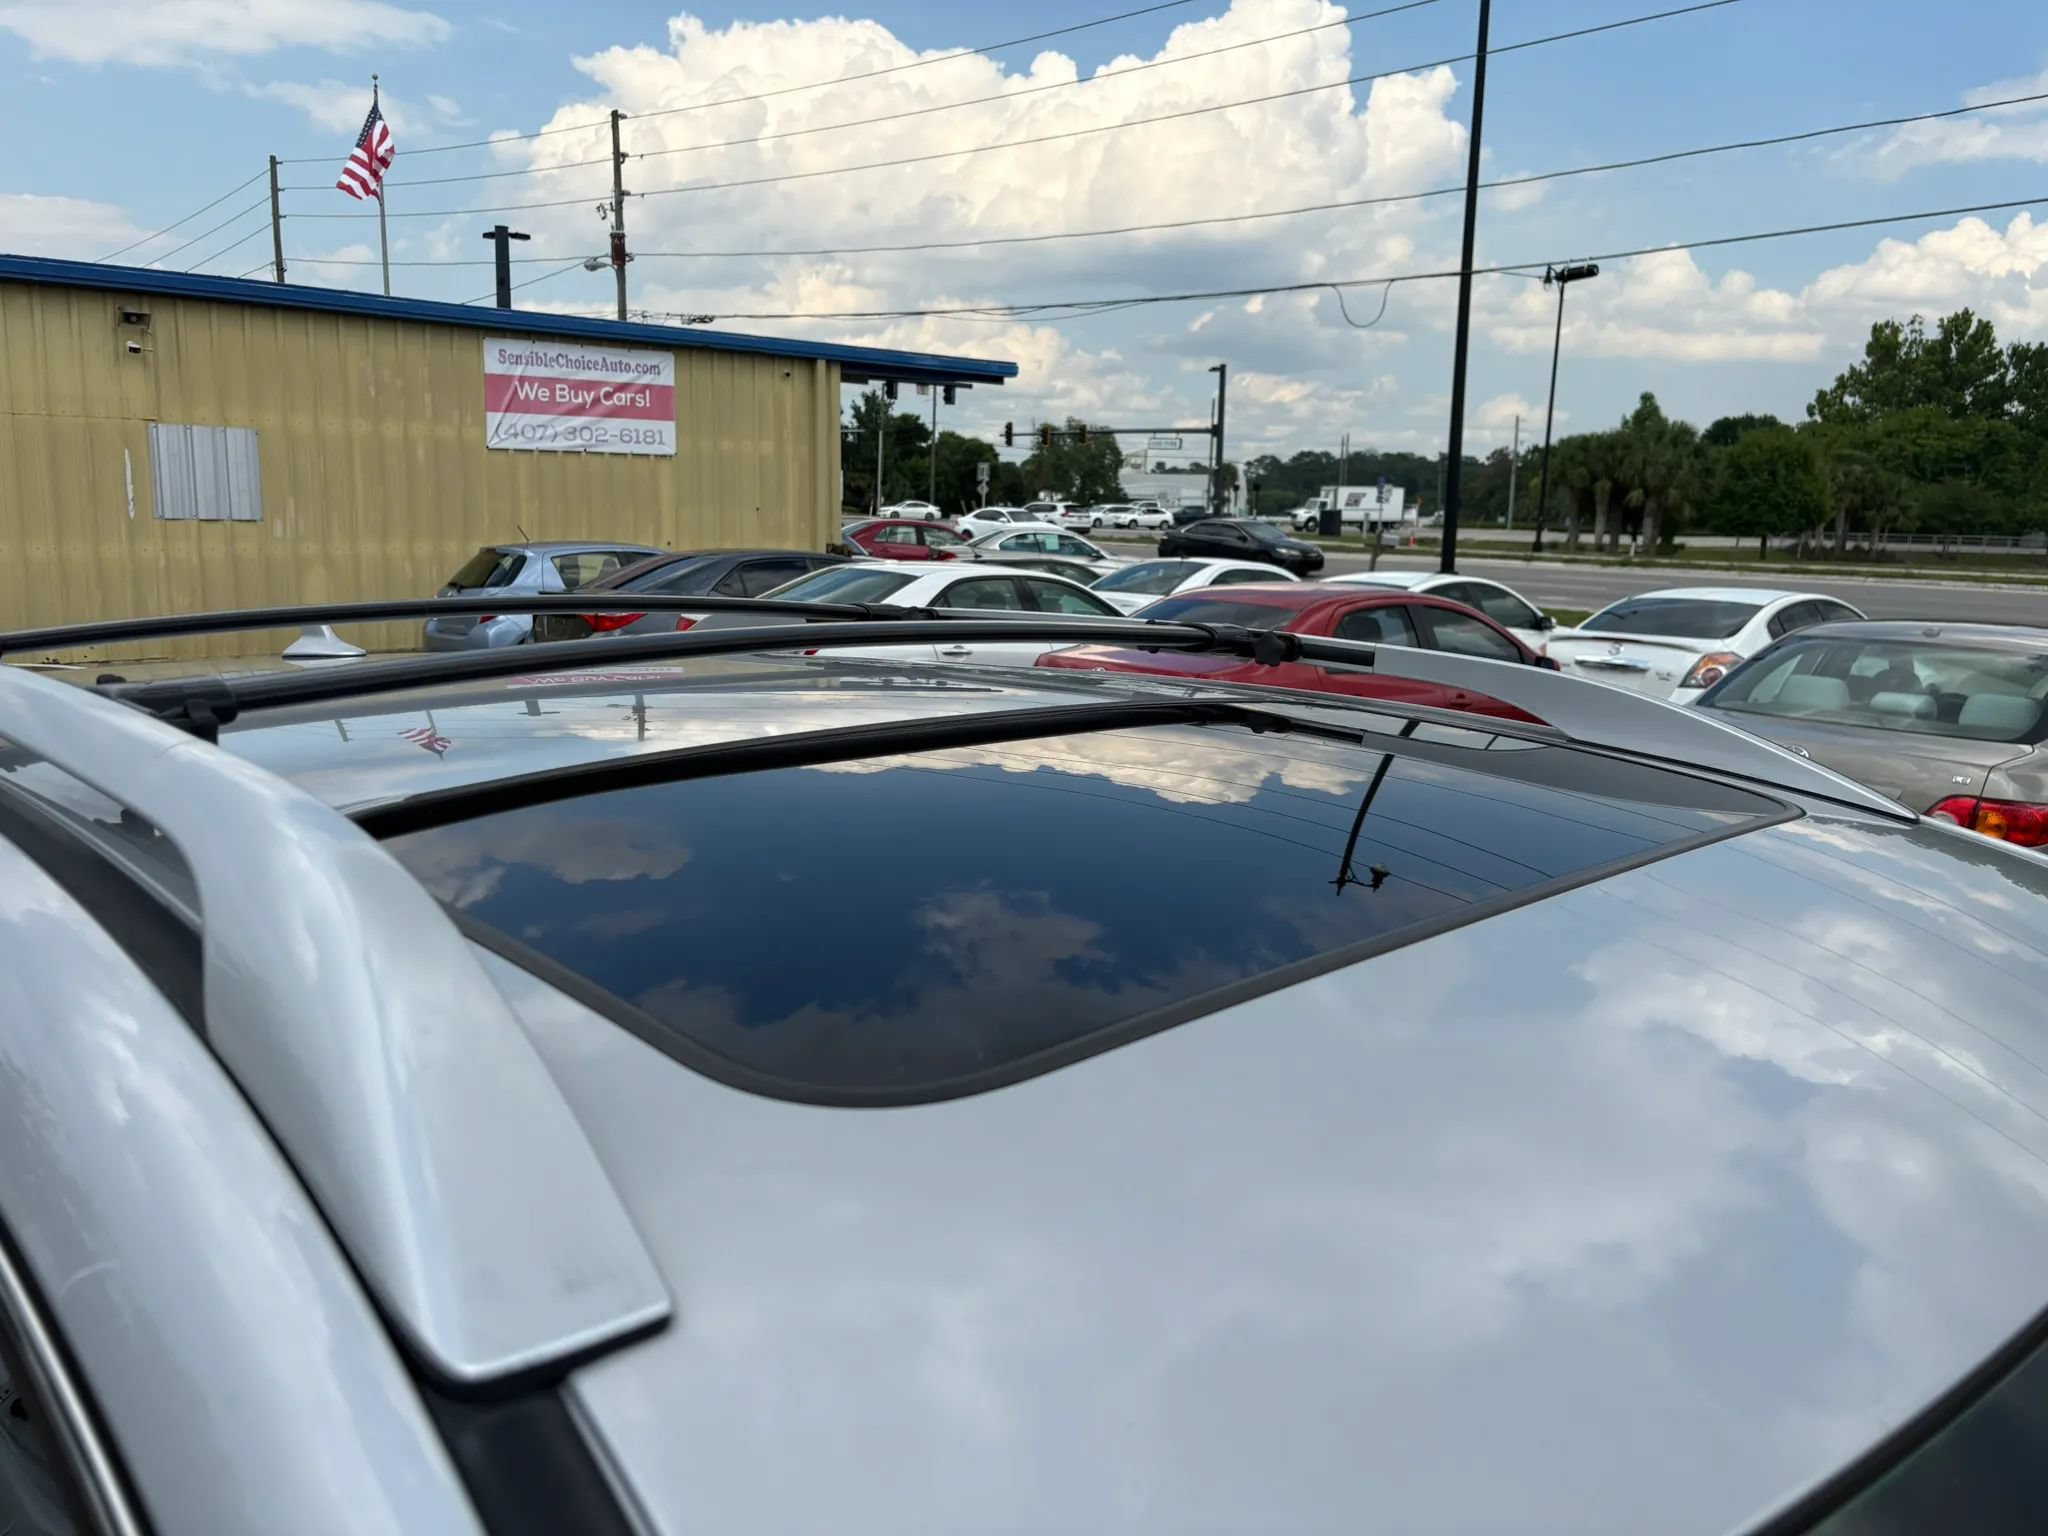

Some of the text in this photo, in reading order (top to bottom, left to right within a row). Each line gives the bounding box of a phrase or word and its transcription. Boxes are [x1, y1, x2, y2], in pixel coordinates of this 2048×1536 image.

[498, 348, 661, 376] SensibleChoiceAuto.com
[514, 381, 651, 409] We Buy Cars!
[495, 422, 666, 446] (407) 302-6181
